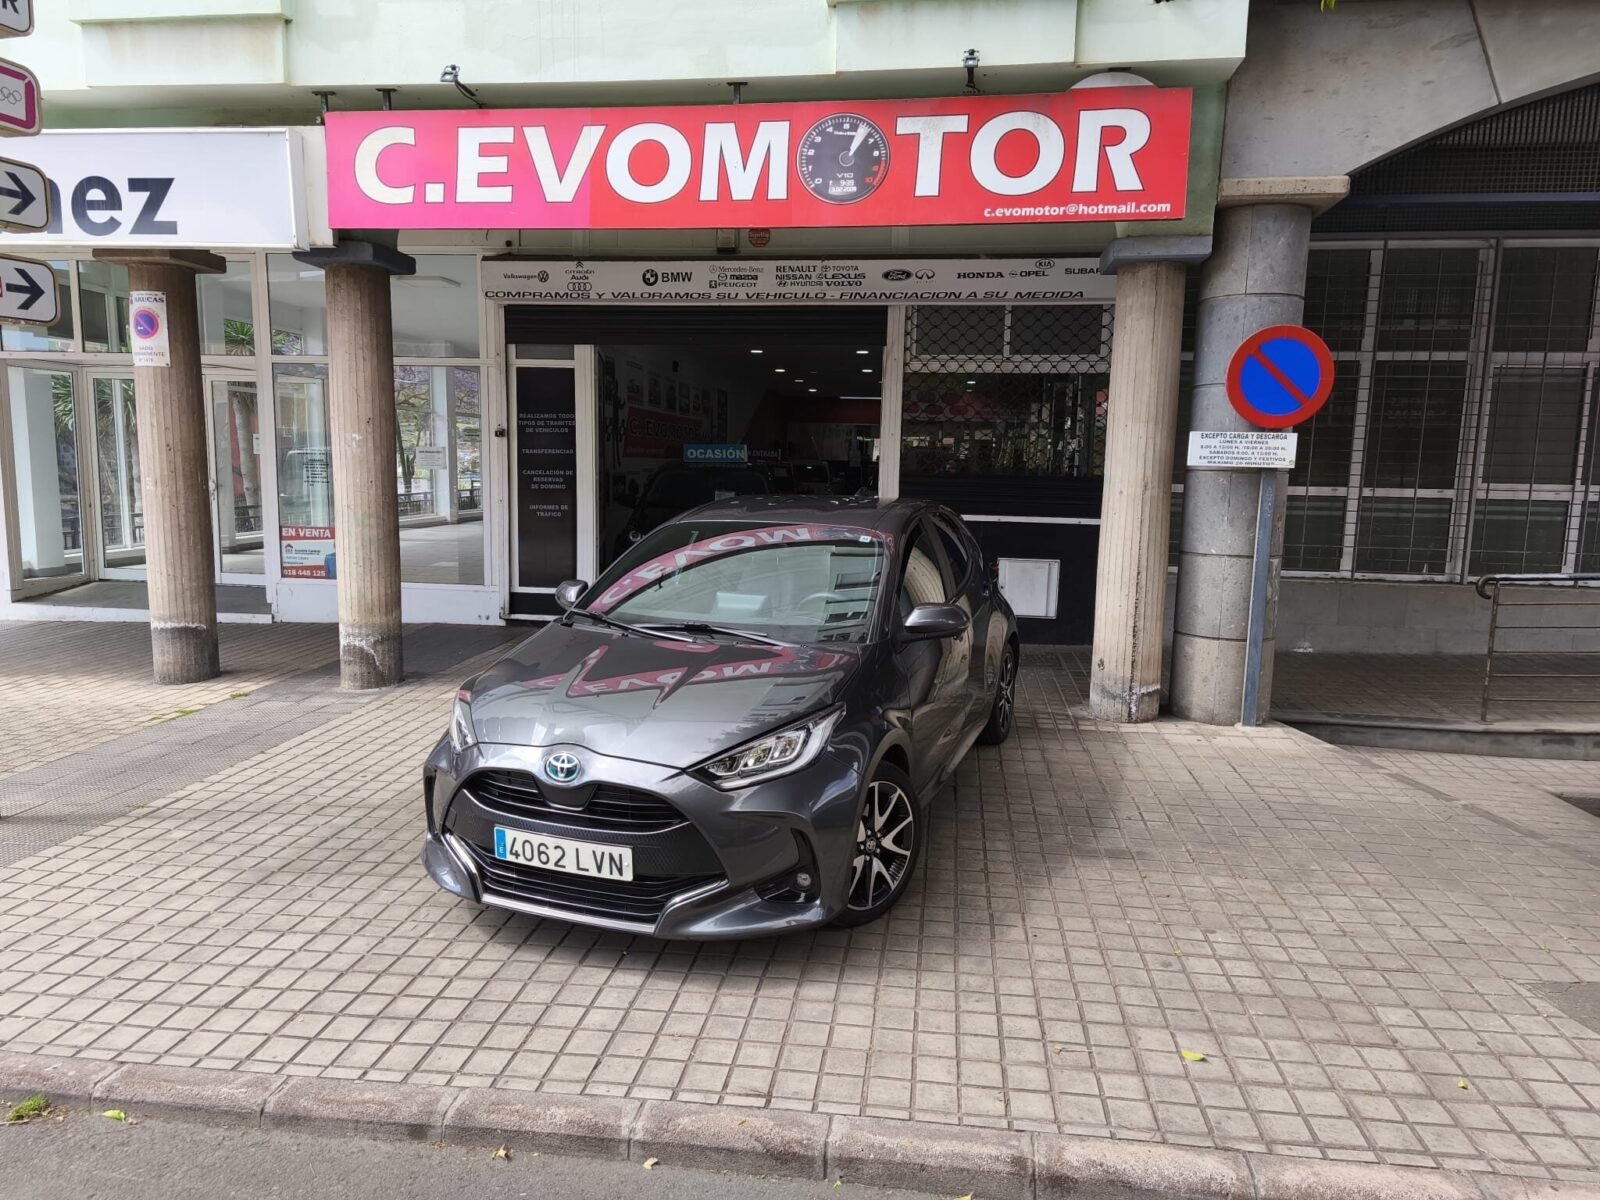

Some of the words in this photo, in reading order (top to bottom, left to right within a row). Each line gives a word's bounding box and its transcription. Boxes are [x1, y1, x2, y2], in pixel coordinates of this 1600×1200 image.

[983, 202, 1172, 218] c.evomotor@hotmail.com
[775, 265, 818, 273] RENAULT
[1037, 260, 1052, 268] KIA
[502, 272, 537, 281] Volkswagen
[661, 271, 693, 283] BMW
[956, 271, 1005, 279] HONDA
[1019, 270, 1048, 278] OPEL
[484, 290, 591, 300] COMPRAMOS
[611, 291, 712, 299] VALORAMOS
[839, 291, 962, 300] FINANCIACION
[965, 291, 978, 299] A
[982, 291, 1008, 299] SU
[1014, 291, 1085, 299] MEDIDA
[687, 446, 745, 459] OCASIÓN
[281, 527, 296, 537] EN
[298, 528, 332, 539] VENTA
[509, 836, 567, 869] 4062
[575, 847, 624, 878] LVN
